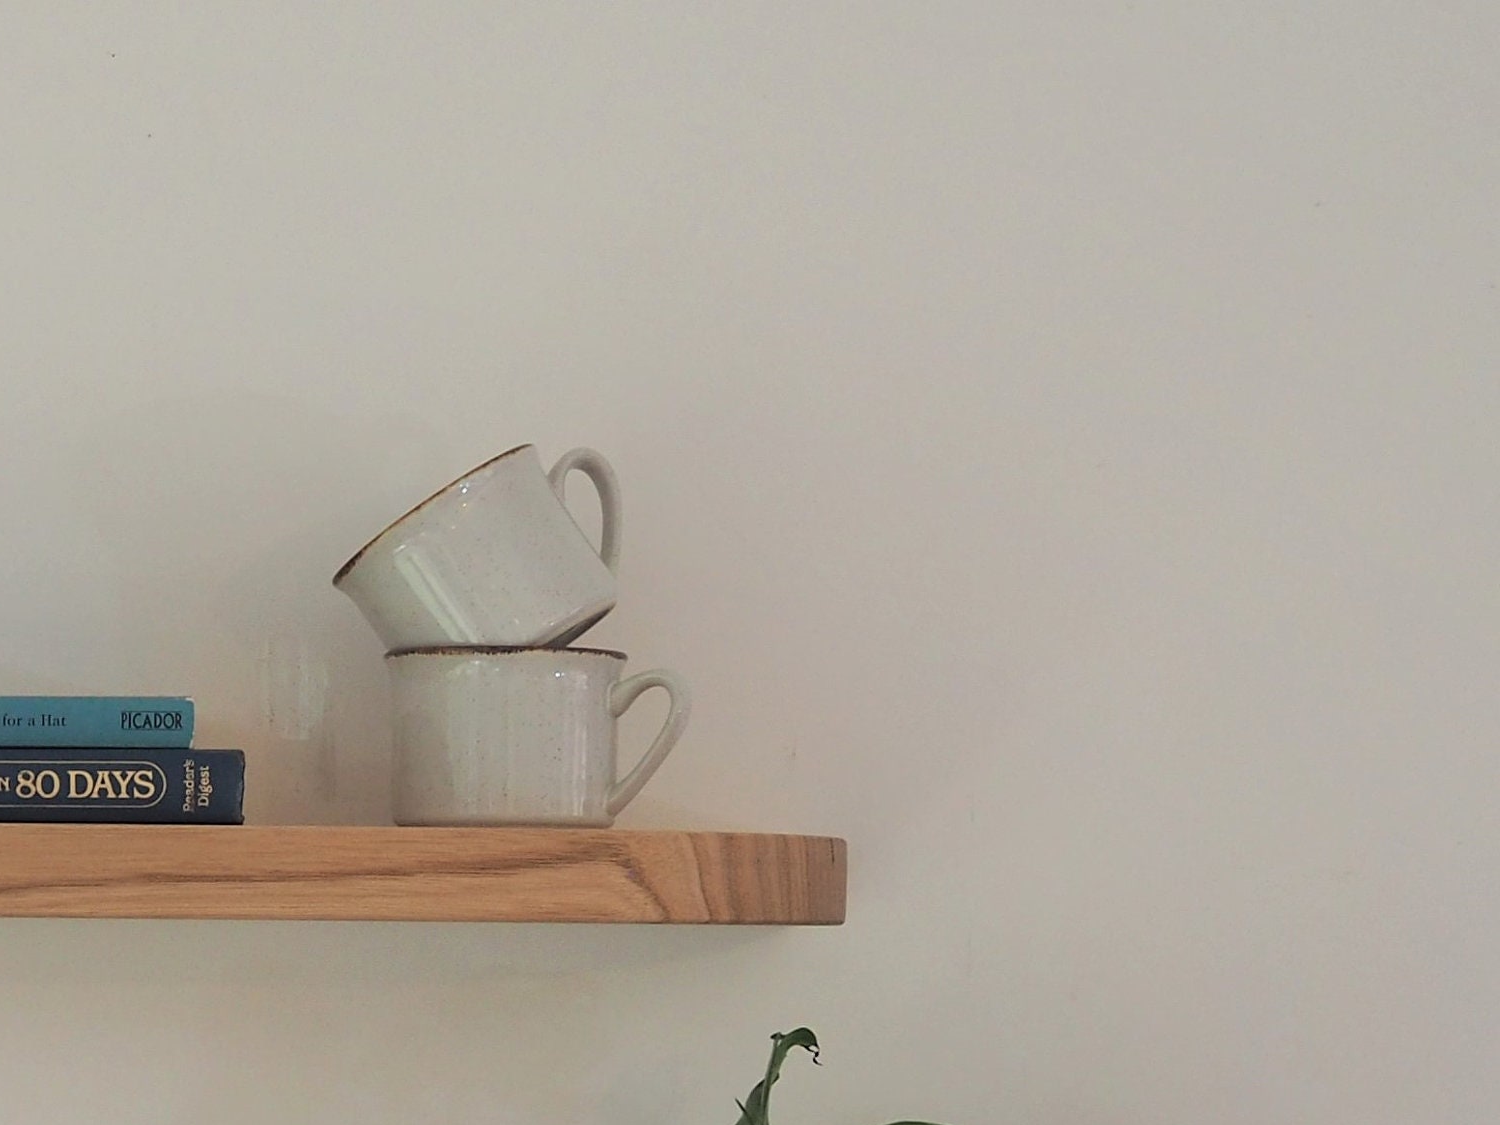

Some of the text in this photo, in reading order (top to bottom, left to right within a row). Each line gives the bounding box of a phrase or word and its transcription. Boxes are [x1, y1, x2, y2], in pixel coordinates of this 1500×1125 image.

[2, 713, 23, 727] for
[27, 717, 36, 727] a
[41, 713, 67, 727] Hat
[120, 711, 183, 730] PICADOR
[15, 769, 61, 799] 80
[67, 769, 156, 799] DAYS
[197, 765, 214, 808] Digest
